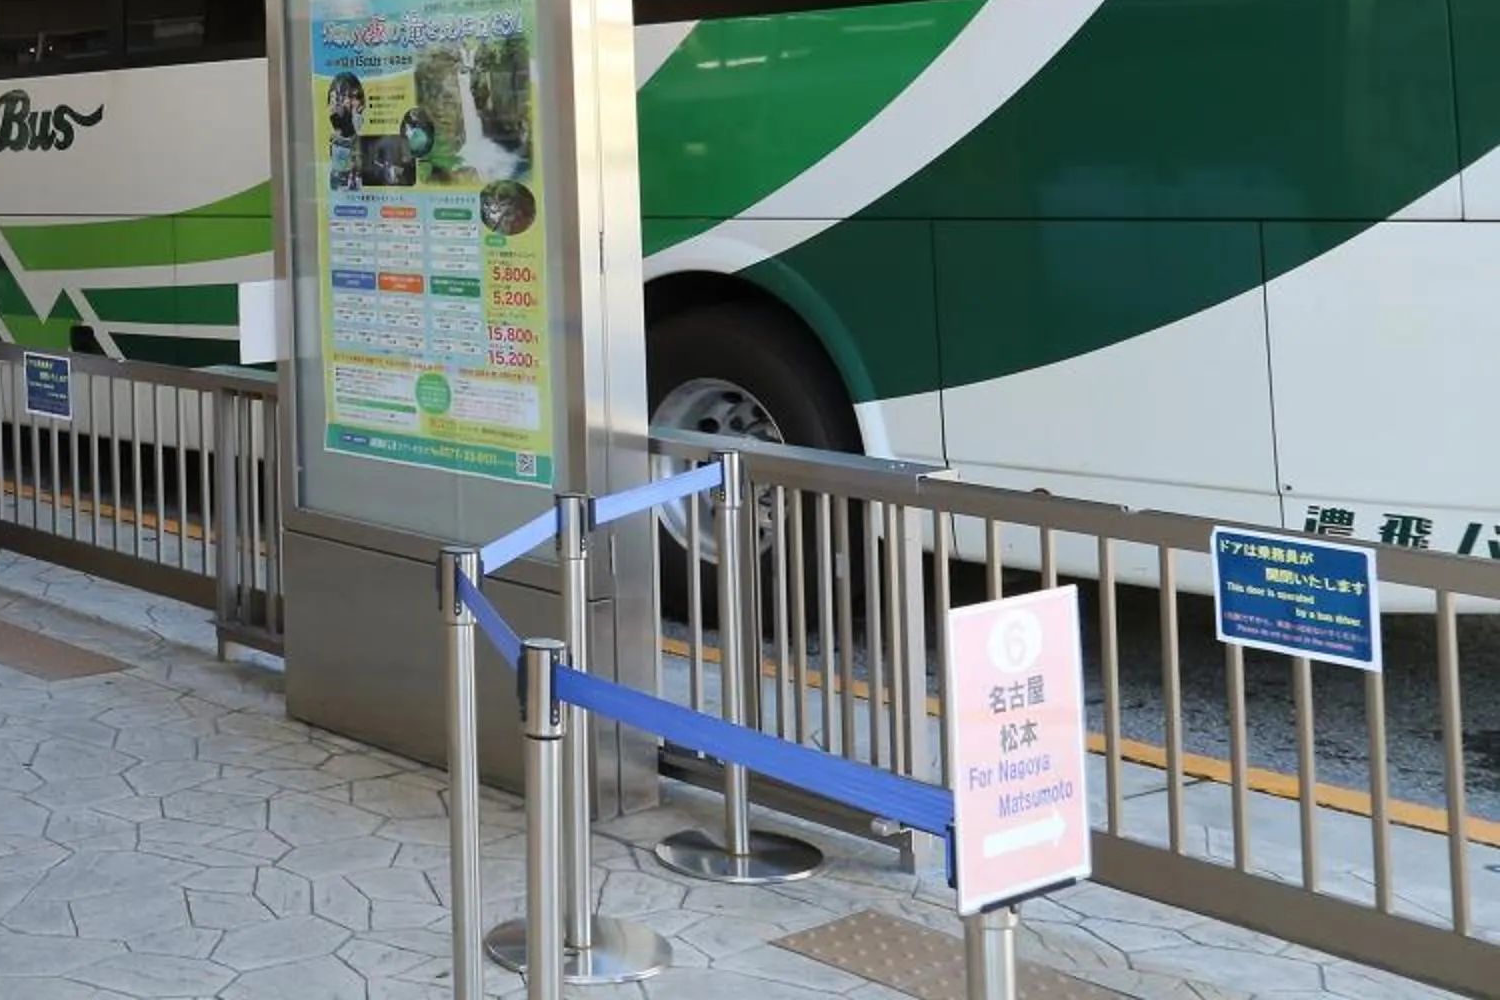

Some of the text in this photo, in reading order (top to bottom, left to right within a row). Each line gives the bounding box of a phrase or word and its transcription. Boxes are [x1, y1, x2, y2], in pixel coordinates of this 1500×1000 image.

[1219, 538, 1315, 566] ドアは乗務員が
[1226, 580, 1245, 593] This
[1246, 584, 1265, 597] door
[1266, 587, 1275, 597] is
[1265, 566, 1366, 597] 開閉いたします
[1294, 607, 1308, 620] by
[1316, 611, 1334, 623] bus
[1002, 619, 1027, 667] 6
[989, 674, 1045, 715] 名古屋
[1000, 719, 1039, 754] 松本
[968, 752, 1052, 792] For Nagoya
[997, 778, 1074, 818] Matsumoto
